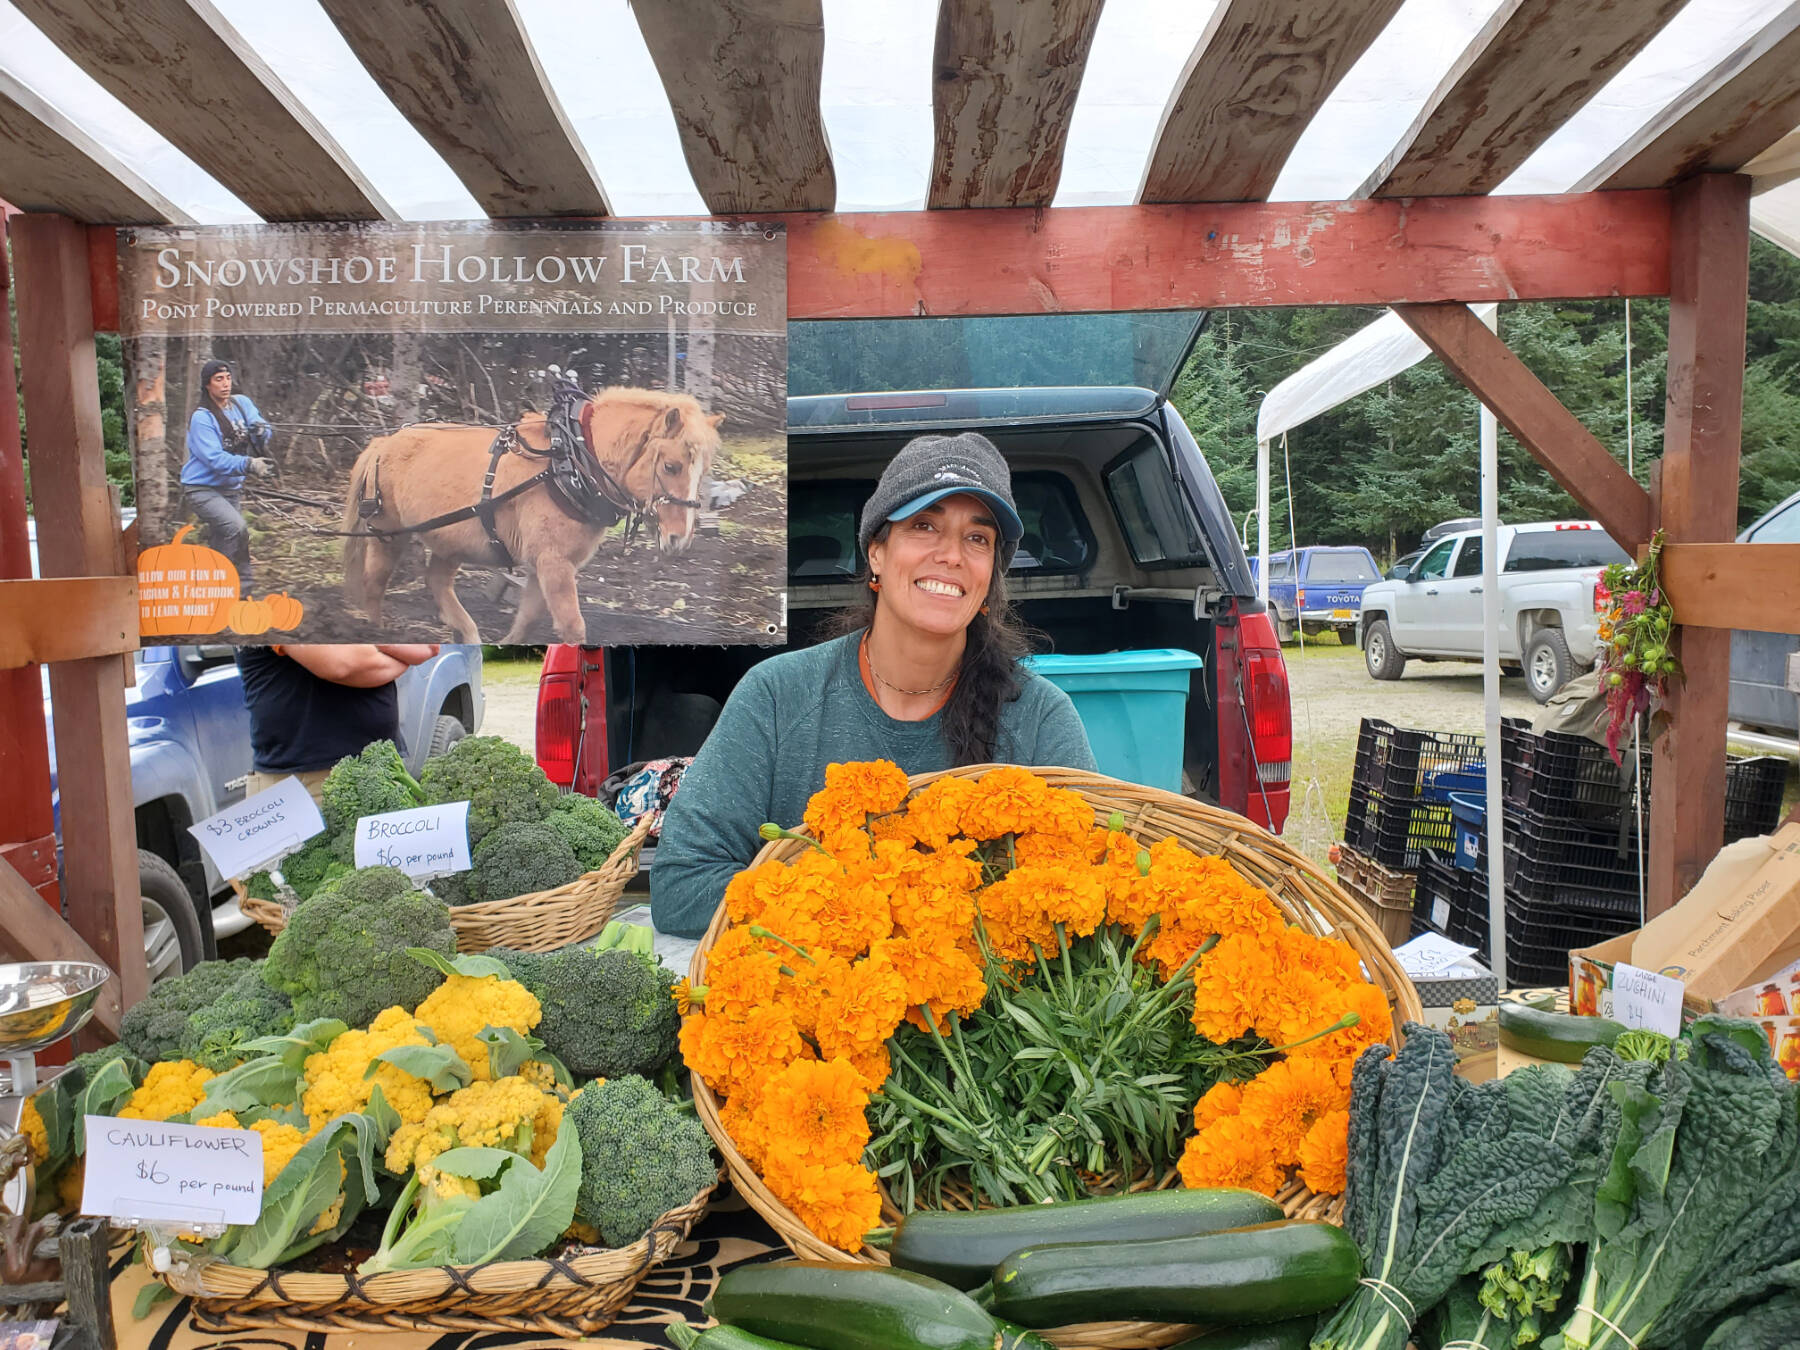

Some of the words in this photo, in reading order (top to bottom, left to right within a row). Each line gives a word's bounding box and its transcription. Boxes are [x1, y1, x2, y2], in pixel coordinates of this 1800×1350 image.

[155, 248, 398, 289] SNOWSHOE
[410, 243, 607, 284] HOLLOW
[619, 244, 747, 284] FARM
[142, 298, 200, 320] PONY
[206, 297, 302, 319] POWERED
[308, 295, 472, 316] PERMACULTURE
[478, 294, 602, 315] PERENNIALS
[607, 301, 652, 315] AND
[659, 295, 758, 317] PRODUCE
[213, 569, 227, 581] ON
[172, 585, 181, 599] &
[183, 585, 235, 599] FACEBOOK
[1326, 595, 1360, 604] TOYOTA
[141, 605, 150, 619] TO
[152, 604, 179, 618] LEARN
[206, 818, 233, 837] $3
[234, 797, 285, 827] BROCCOLI
[237, 813, 285, 842] CROWNS
[368, 816, 440, 840] BROCCOLI
[377, 845, 402, 868] $6
[405, 854, 422, 867] per
[426, 848, 454, 867] pound
[107, 1129, 250, 1157] CAULIFLOWER
[136, 1159, 170, 1185] $6
[179, 1179, 208, 1194] per
[213, 1180, 255, 1196] pound
